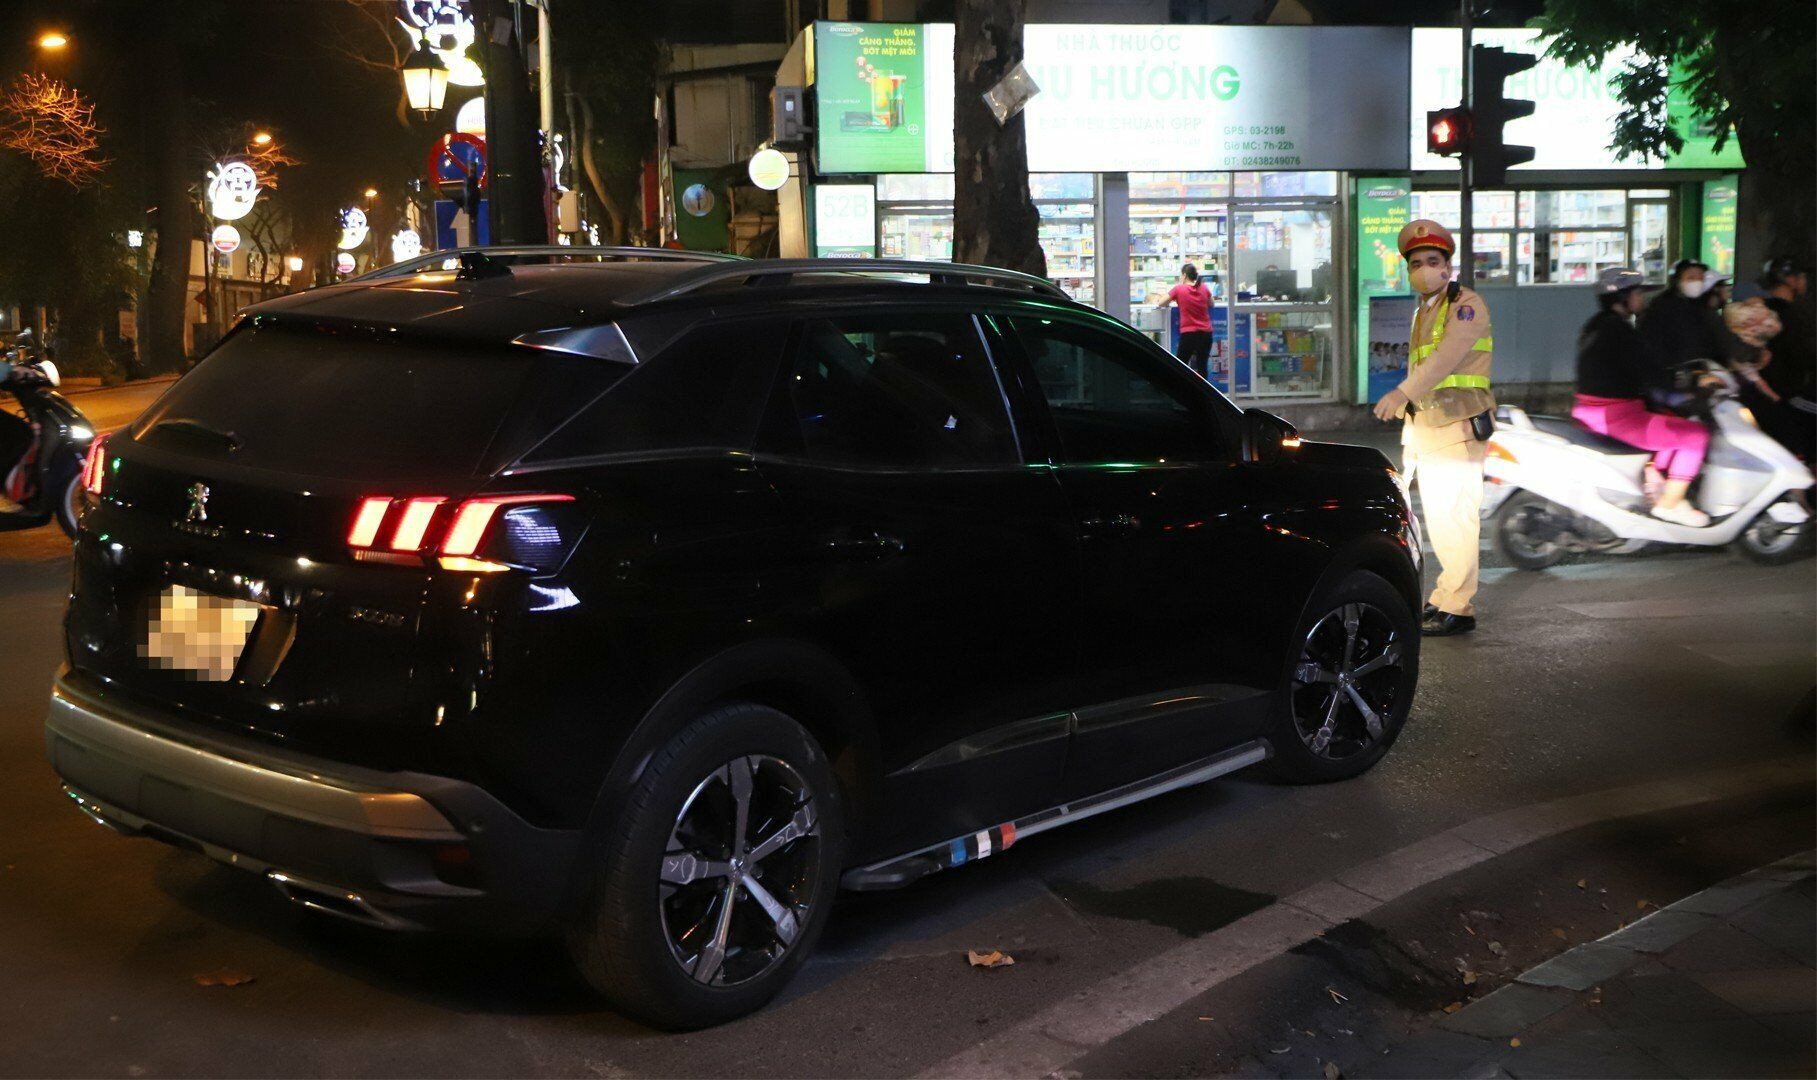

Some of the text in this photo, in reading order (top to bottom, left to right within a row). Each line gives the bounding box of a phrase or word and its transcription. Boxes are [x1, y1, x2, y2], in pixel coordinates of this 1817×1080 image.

[1090, 59, 1241, 101] HƯƠNG
[1224, 126, 1247, 135] GPS:
[1243, 141, 1260, 150] MC:
[1263, 141, 1294, 150] 7h-22h
[823, 194, 868, 218] 52B
